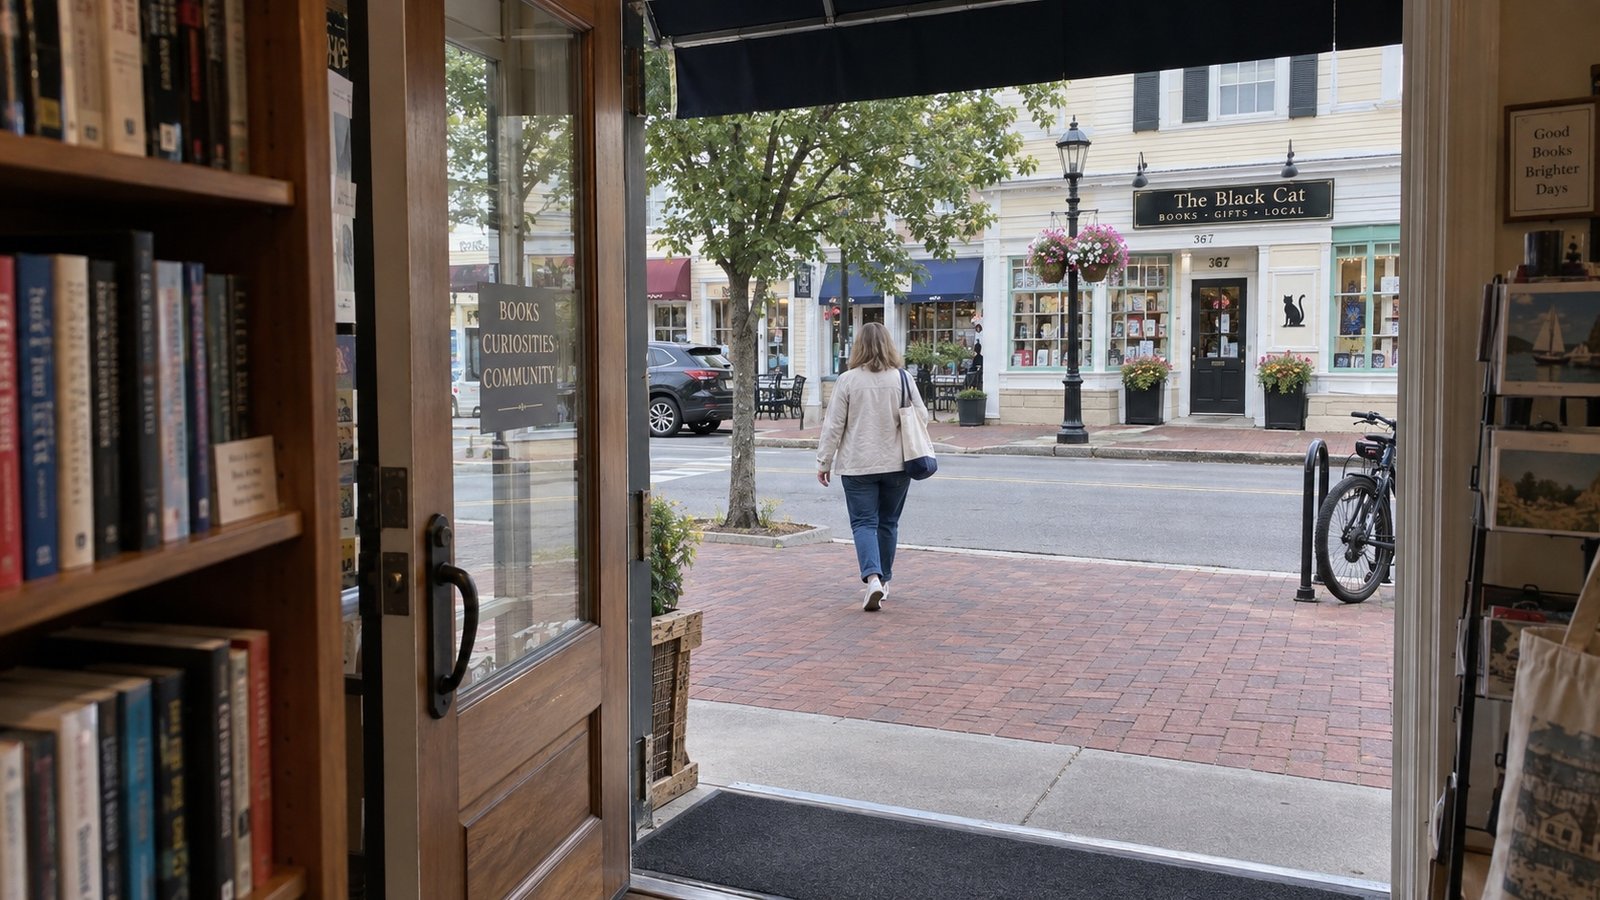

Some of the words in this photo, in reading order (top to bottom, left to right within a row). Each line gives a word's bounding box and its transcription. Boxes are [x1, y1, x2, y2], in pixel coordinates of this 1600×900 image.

[1534, 125, 1570, 140] Good
[1532, 145, 1573, 159] Books
[1525, 164, 1580, 179] Brighter
[1174, 193, 1207, 208] The
[1215, 188, 1264, 206] Black
[1273, 187, 1305, 202] Cat
[1535, 183, 1568, 197] Days
[1159, 212, 1198, 222] BOOKS
[1214, 209, 1248, 218] GIFTS
[1265, 206, 1304, 216] LOCAL
[1193, 234, 1214, 244] 367
[1208, 257, 1230, 268] 367
[499, 301, 540, 322] BOOKS
[482, 333, 555, 354] CURIOSITIES
[483, 365, 555, 389] COMMUNITY
